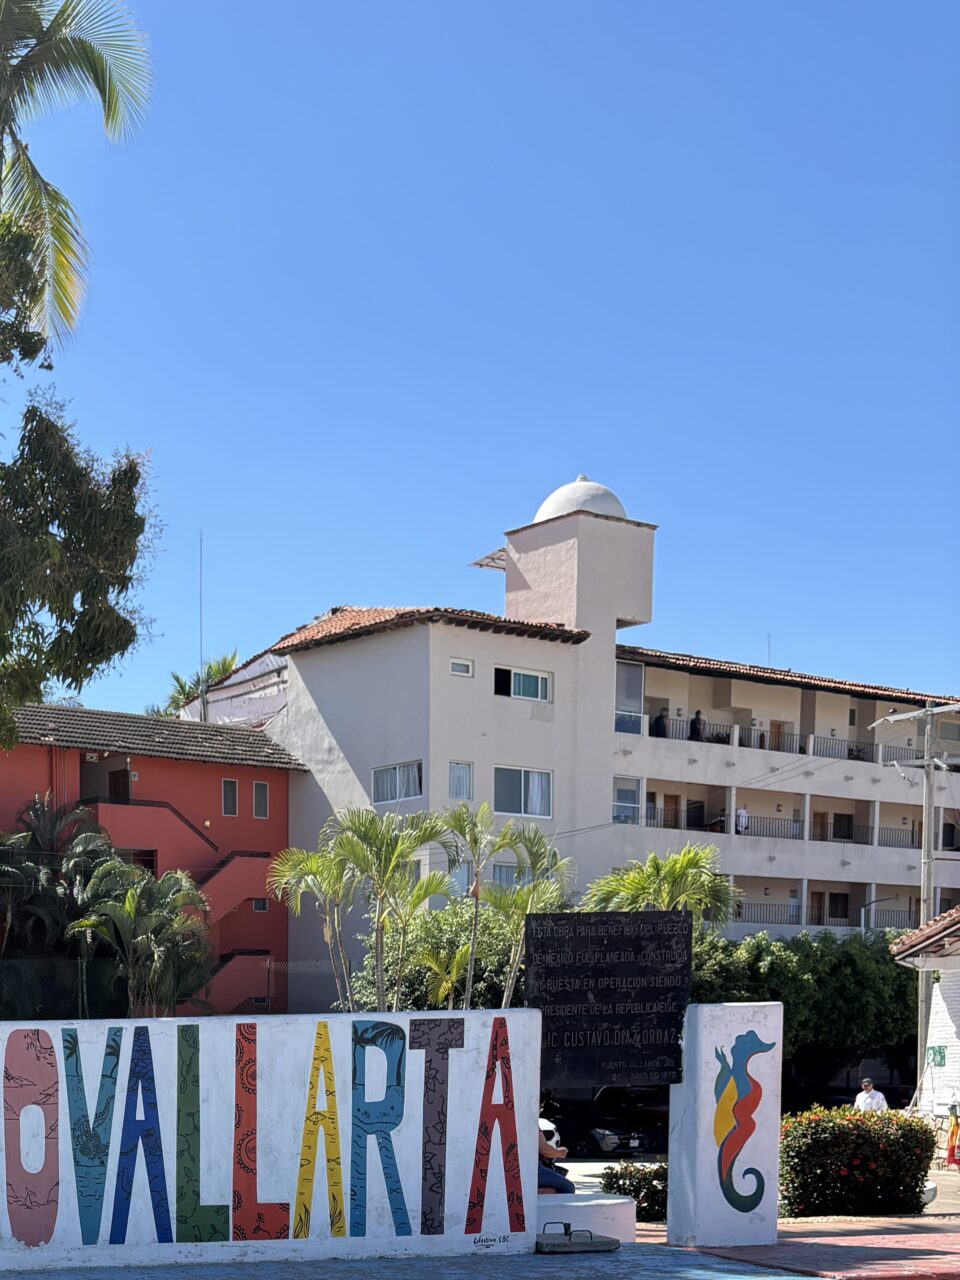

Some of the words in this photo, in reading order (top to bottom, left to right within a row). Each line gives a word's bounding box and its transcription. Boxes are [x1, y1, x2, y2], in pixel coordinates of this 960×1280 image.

[576, 925, 596, 937] PARA
[657, 922, 689, 935] PUEBLO
[532, 953, 543, 965] DE
[640, 950, 688, 963] CONSTRUIDA
[546, 978, 580, 991] PUESTA
[583, 977, 595, 990] EN
[597, 976, 647, 989] OPERACION
[649, 975, 681, 988] SIENDO
[539, 1003, 588, 1017] PRESIDENTE
[615, 1001, 658, 1015] REPUBLICA
[563, 1030, 610, 1047] GUSTAVO
[614, 1029, 638, 1046] DIAZ
